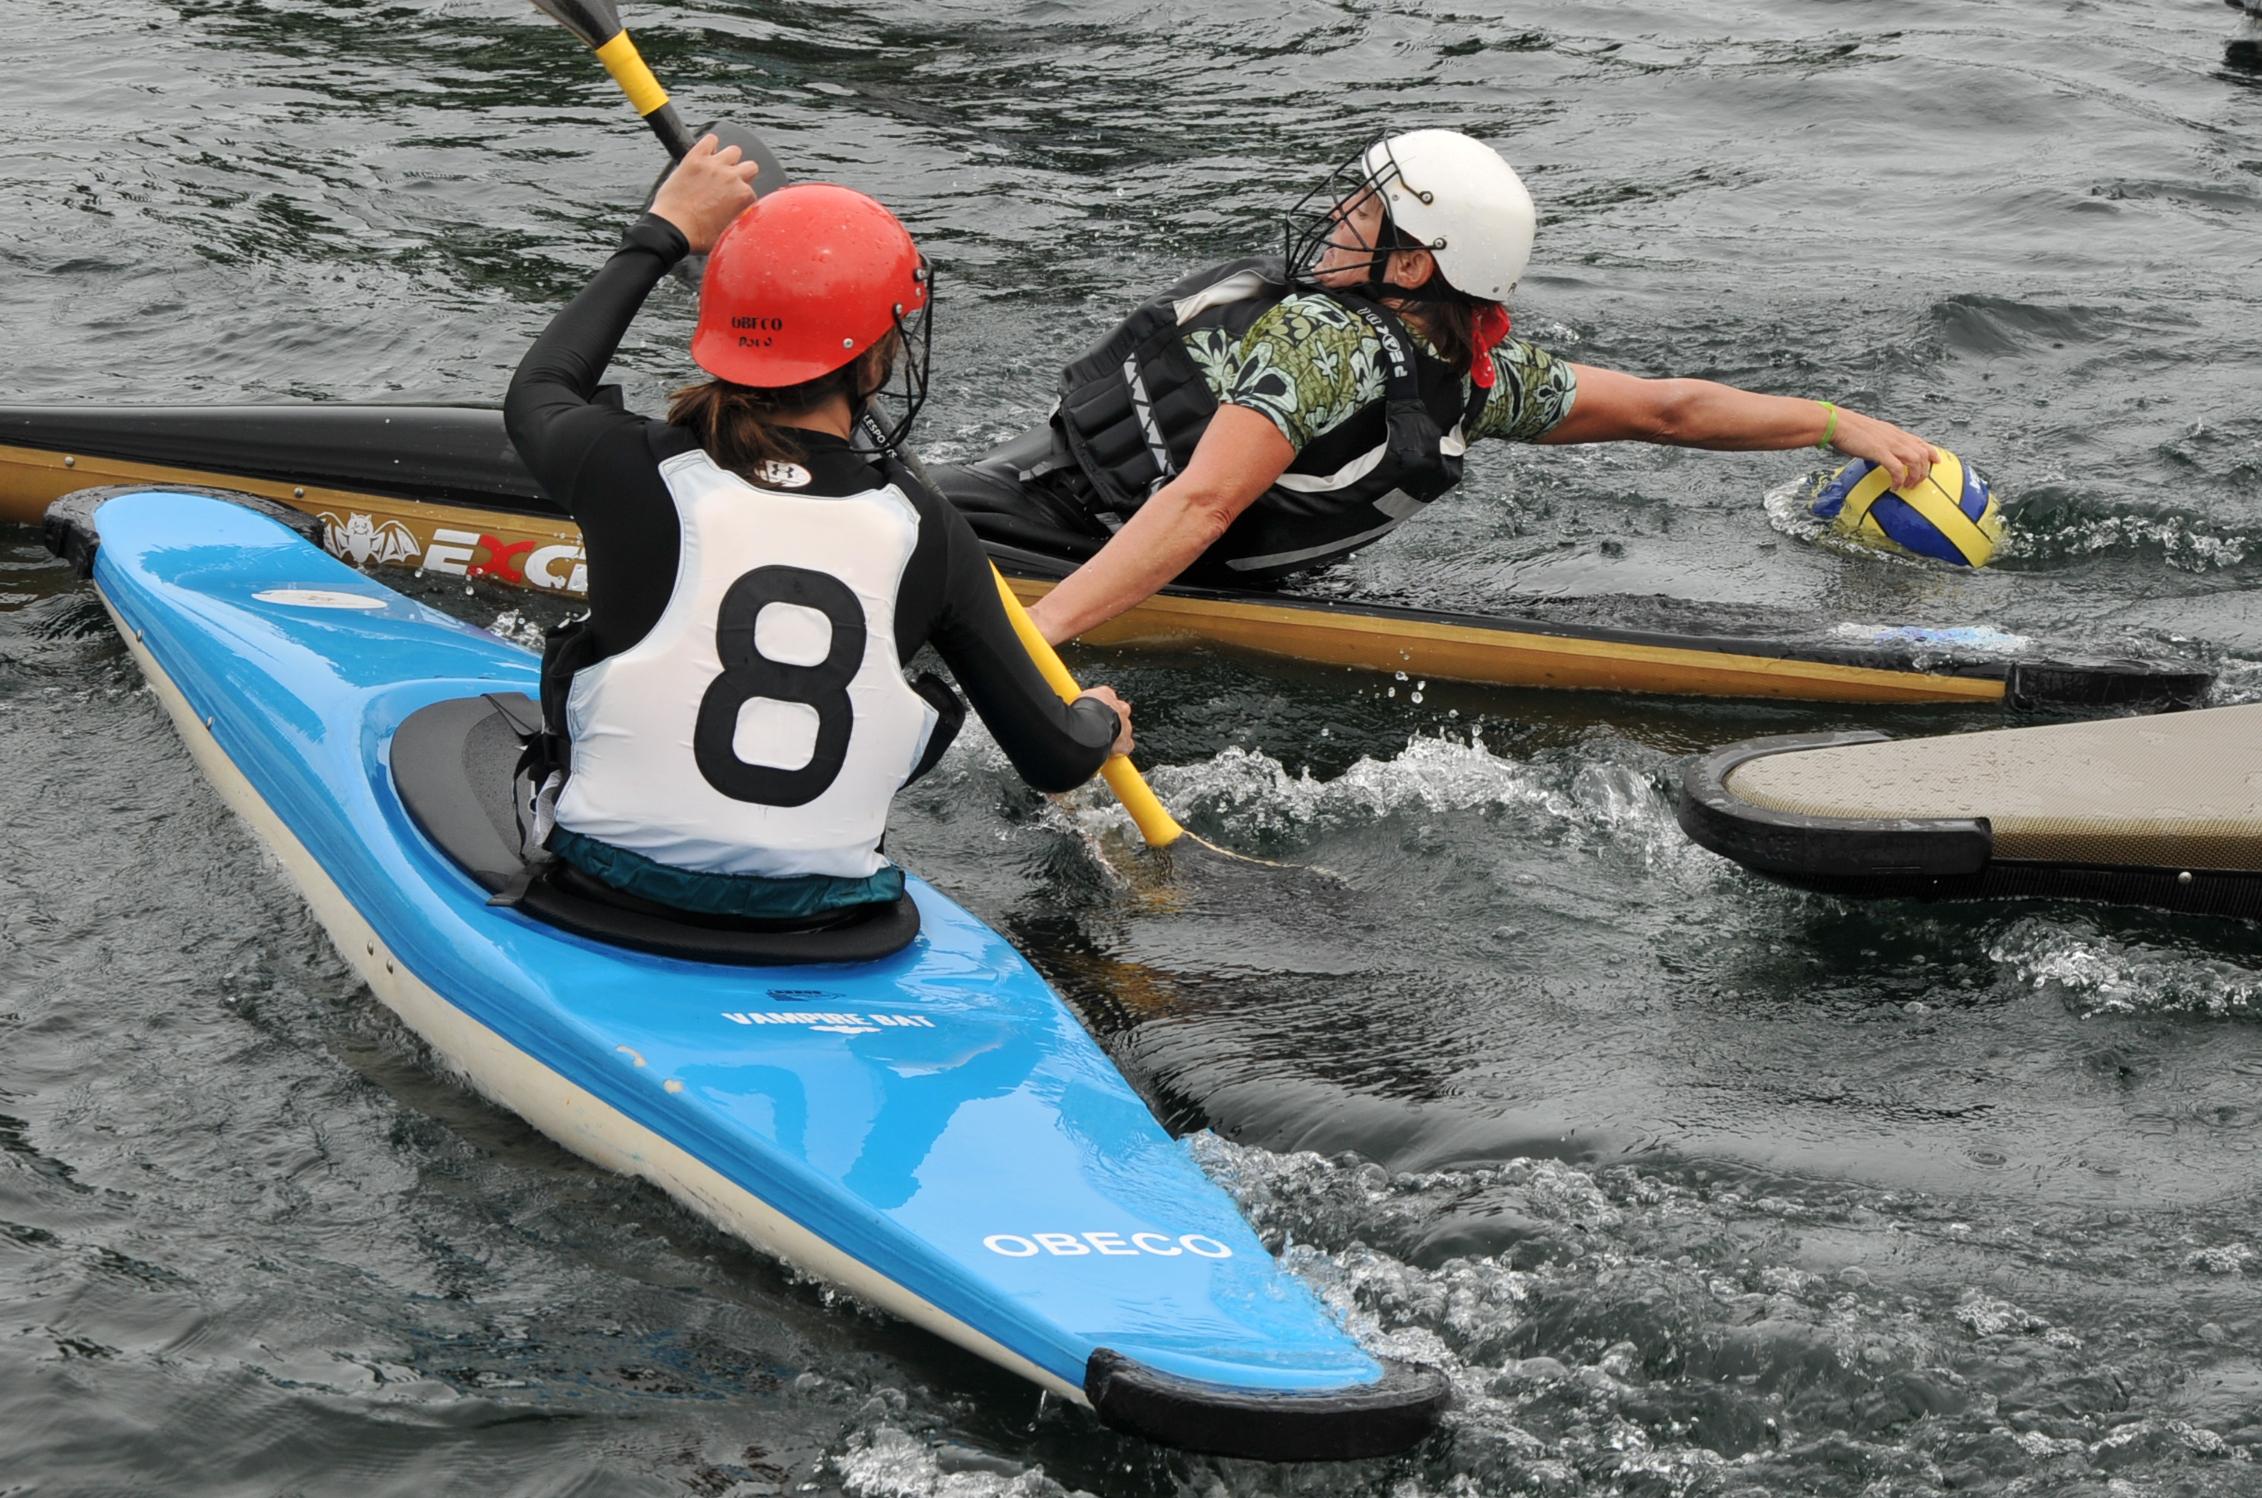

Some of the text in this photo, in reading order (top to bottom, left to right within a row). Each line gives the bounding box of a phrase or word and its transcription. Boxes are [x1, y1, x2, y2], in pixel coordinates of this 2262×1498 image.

[731, 316, 783, 331] OBECO
[693, 564, 868, 808] 8
[721, 1012, 936, 1028] VAMPIRE BAT
[983, 1232, 1232, 1258] OBECO
